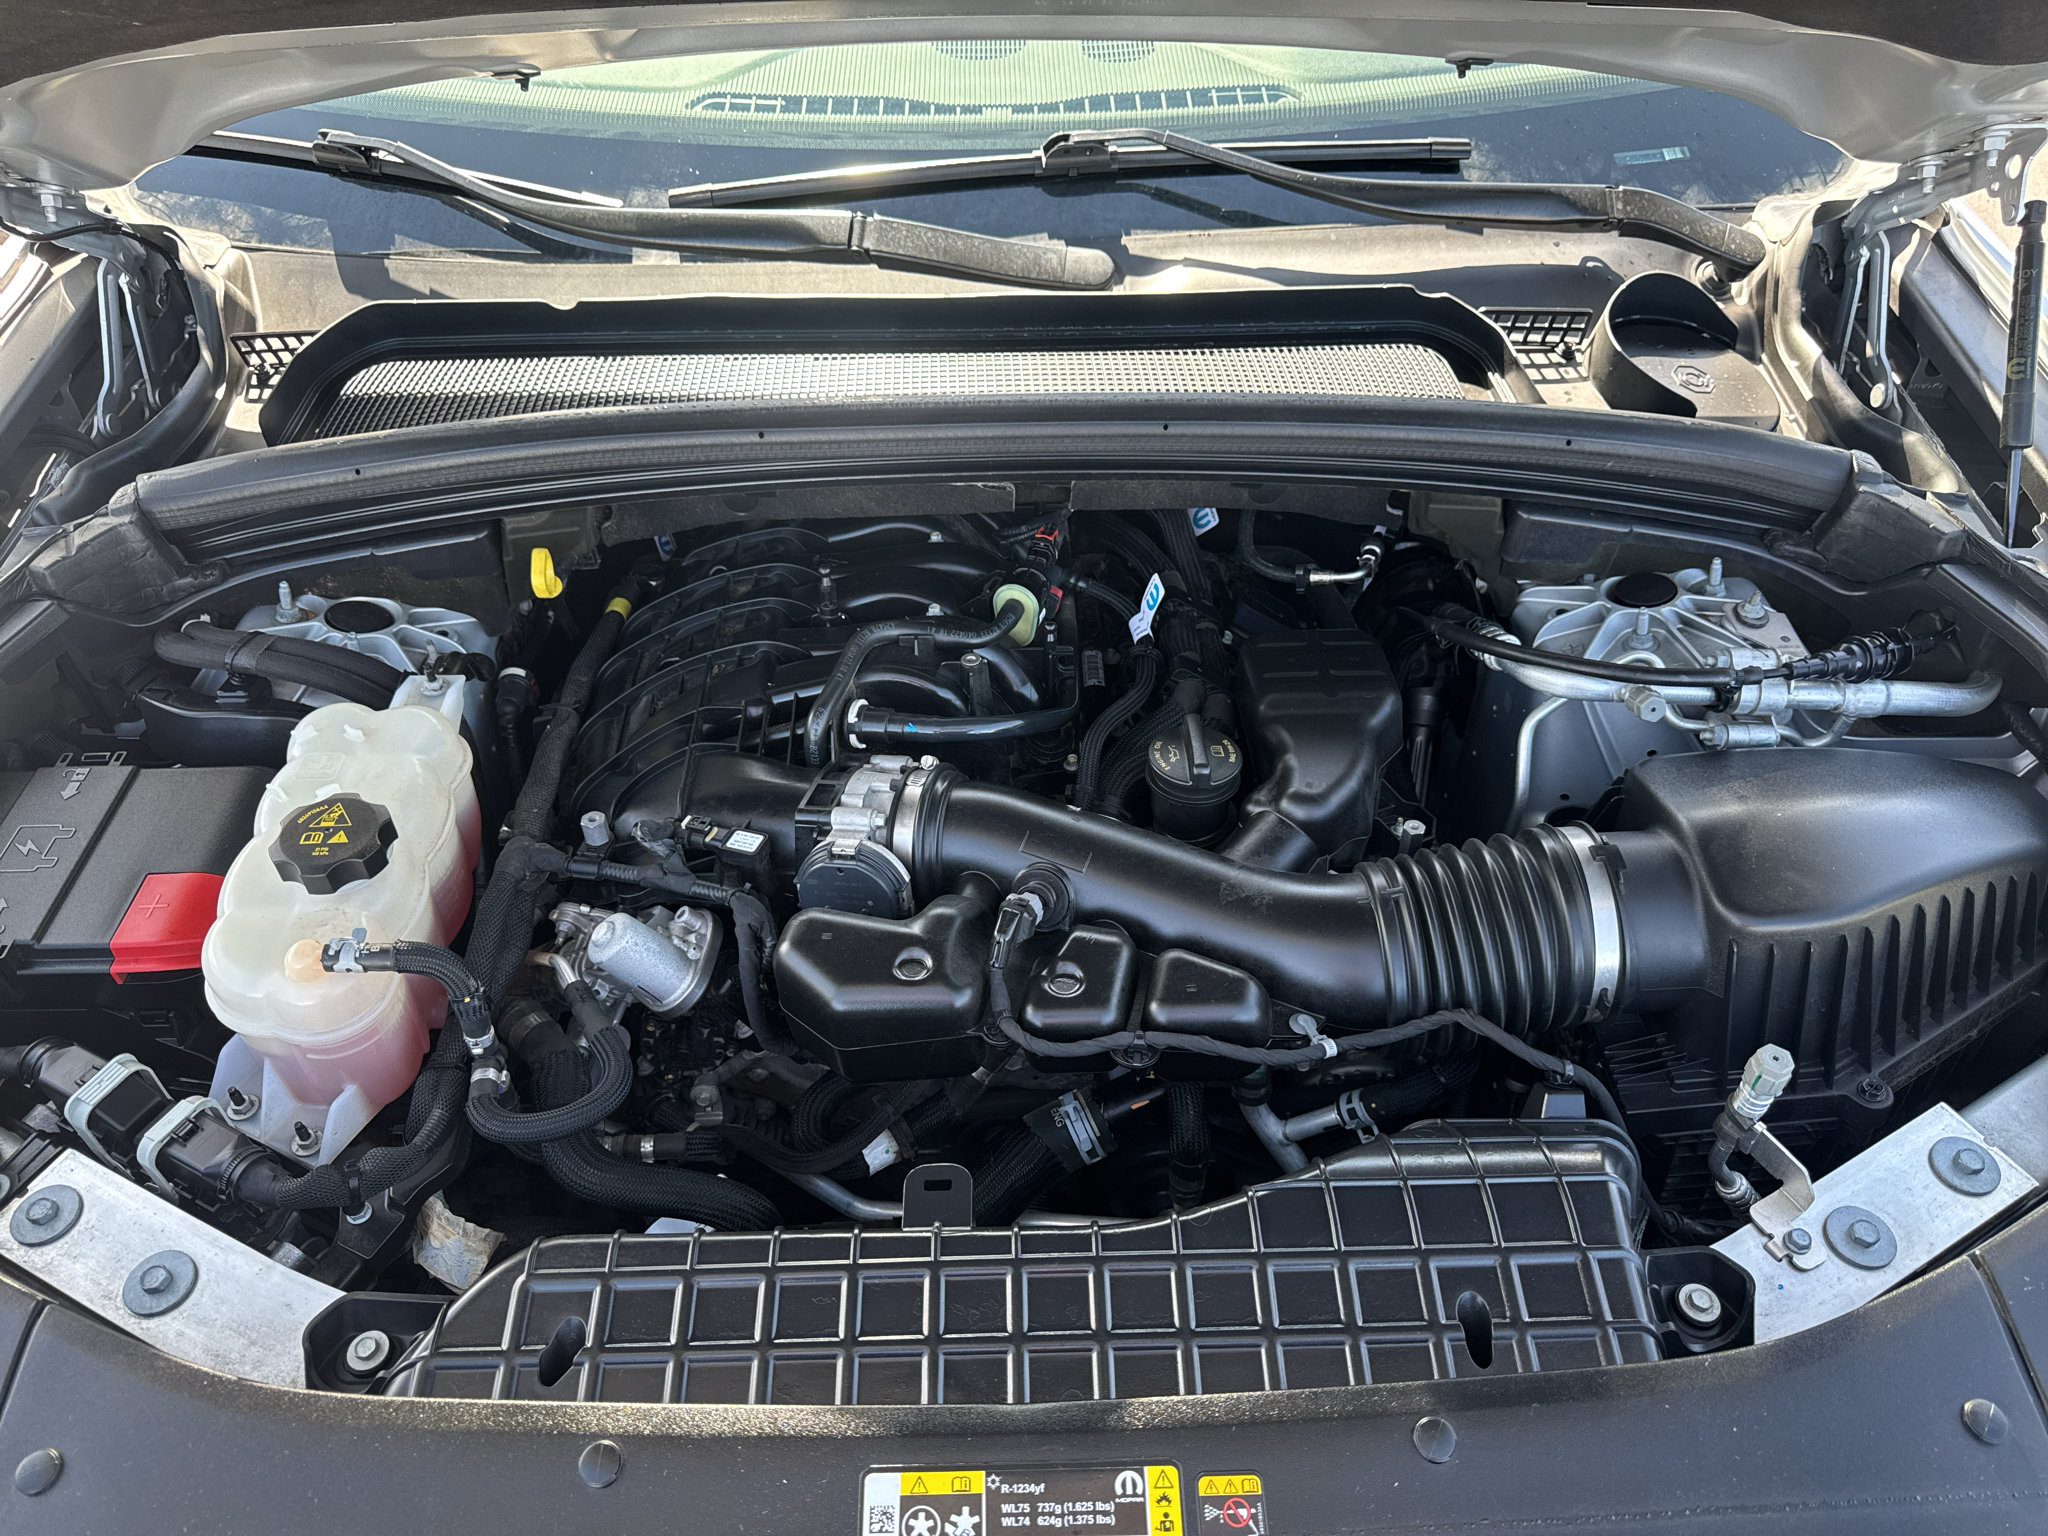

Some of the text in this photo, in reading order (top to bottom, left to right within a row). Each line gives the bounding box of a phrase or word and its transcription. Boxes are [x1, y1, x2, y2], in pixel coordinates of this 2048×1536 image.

[1153, 740, 1171, 771] ENGINE OIL
[1050, 1106, 1065, 1128] ENG
[1000, 1483, 1045, 1495] R-1234yf
[1001, 1500, 1115, 1514] WL75 737g (1.625 lbs)
[1001, 1514, 1116, 1527] WL74 624g (1.375 lbs)
